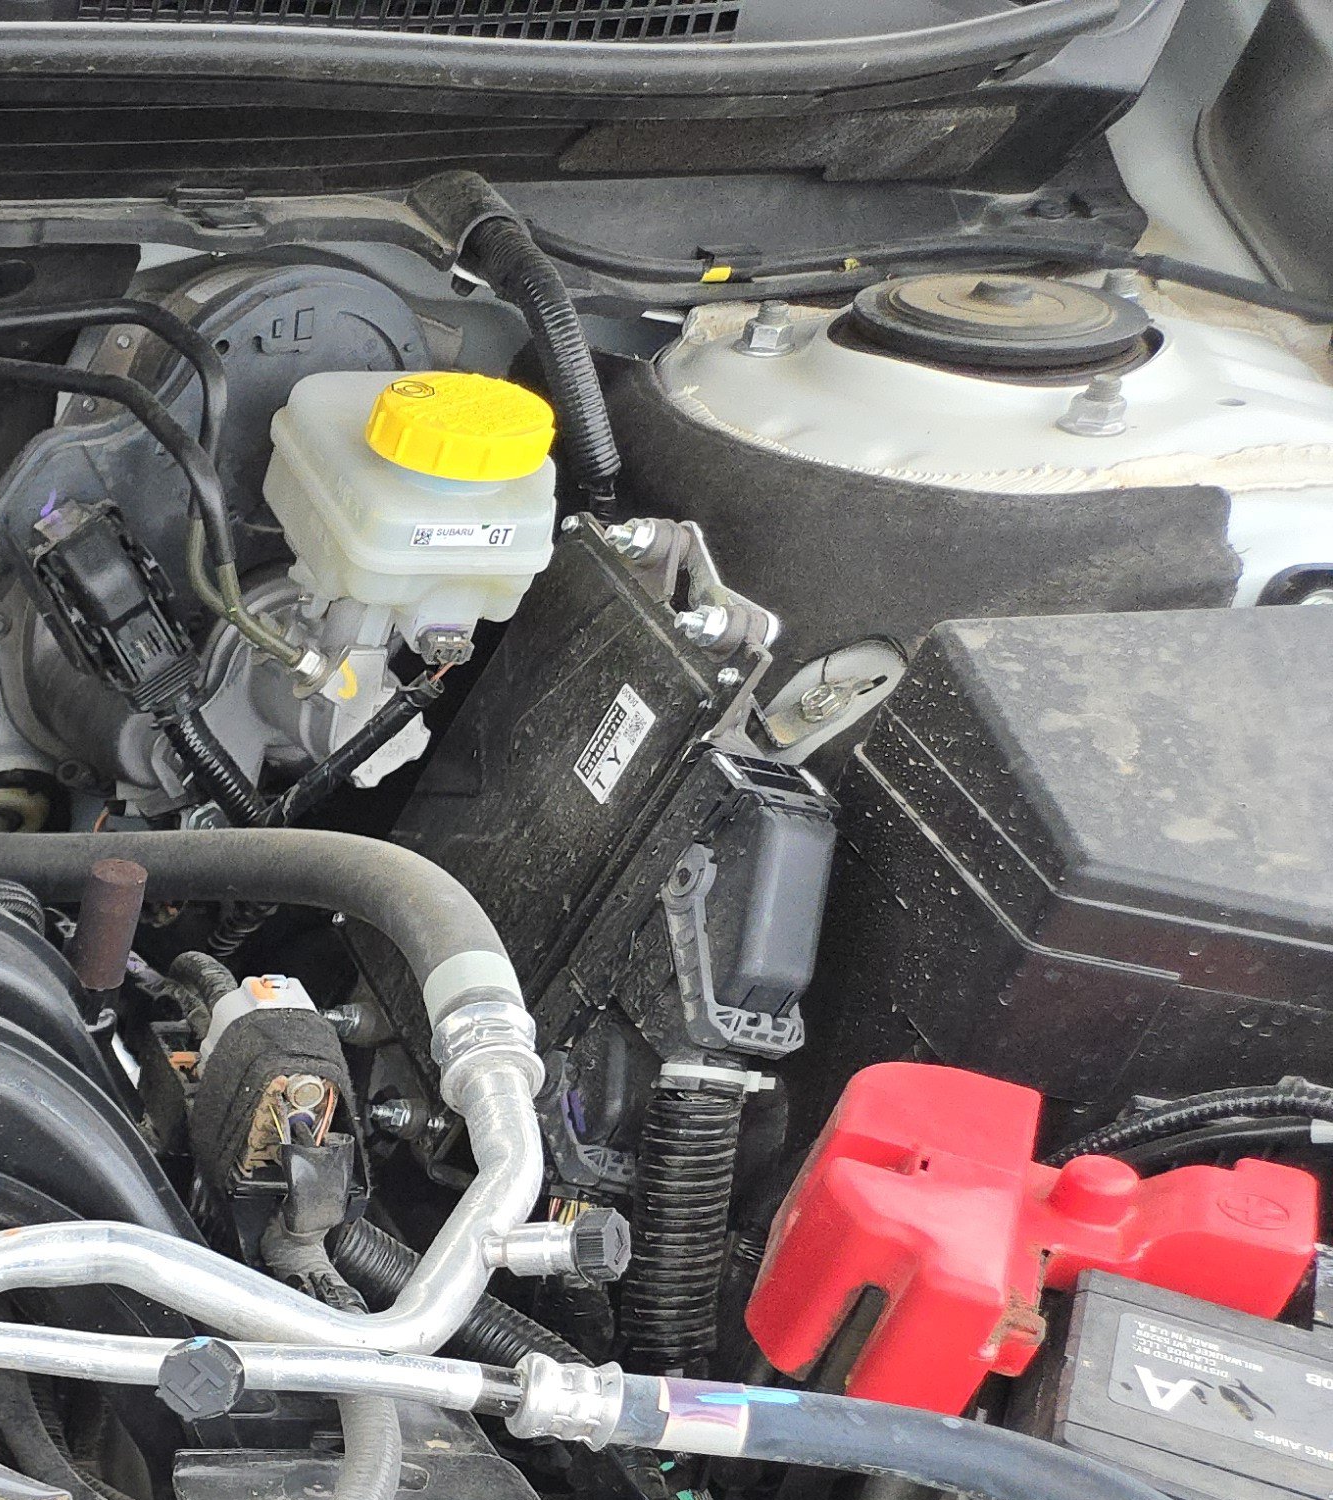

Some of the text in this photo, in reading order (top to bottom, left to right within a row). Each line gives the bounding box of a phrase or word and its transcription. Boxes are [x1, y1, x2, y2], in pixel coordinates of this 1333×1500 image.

[436, 528, 513, 545] SUBARU GT
[591, 771, 606, 790] T
[606, 745, 621, 766] Y
[1186, 1334, 1220, 1352] MADE
[1153, 1349, 1230, 1379] DISTRIBUTED
[1133, 1364, 1198, 1412] A
[1253, 1429, 1302, 1450] AMPS
